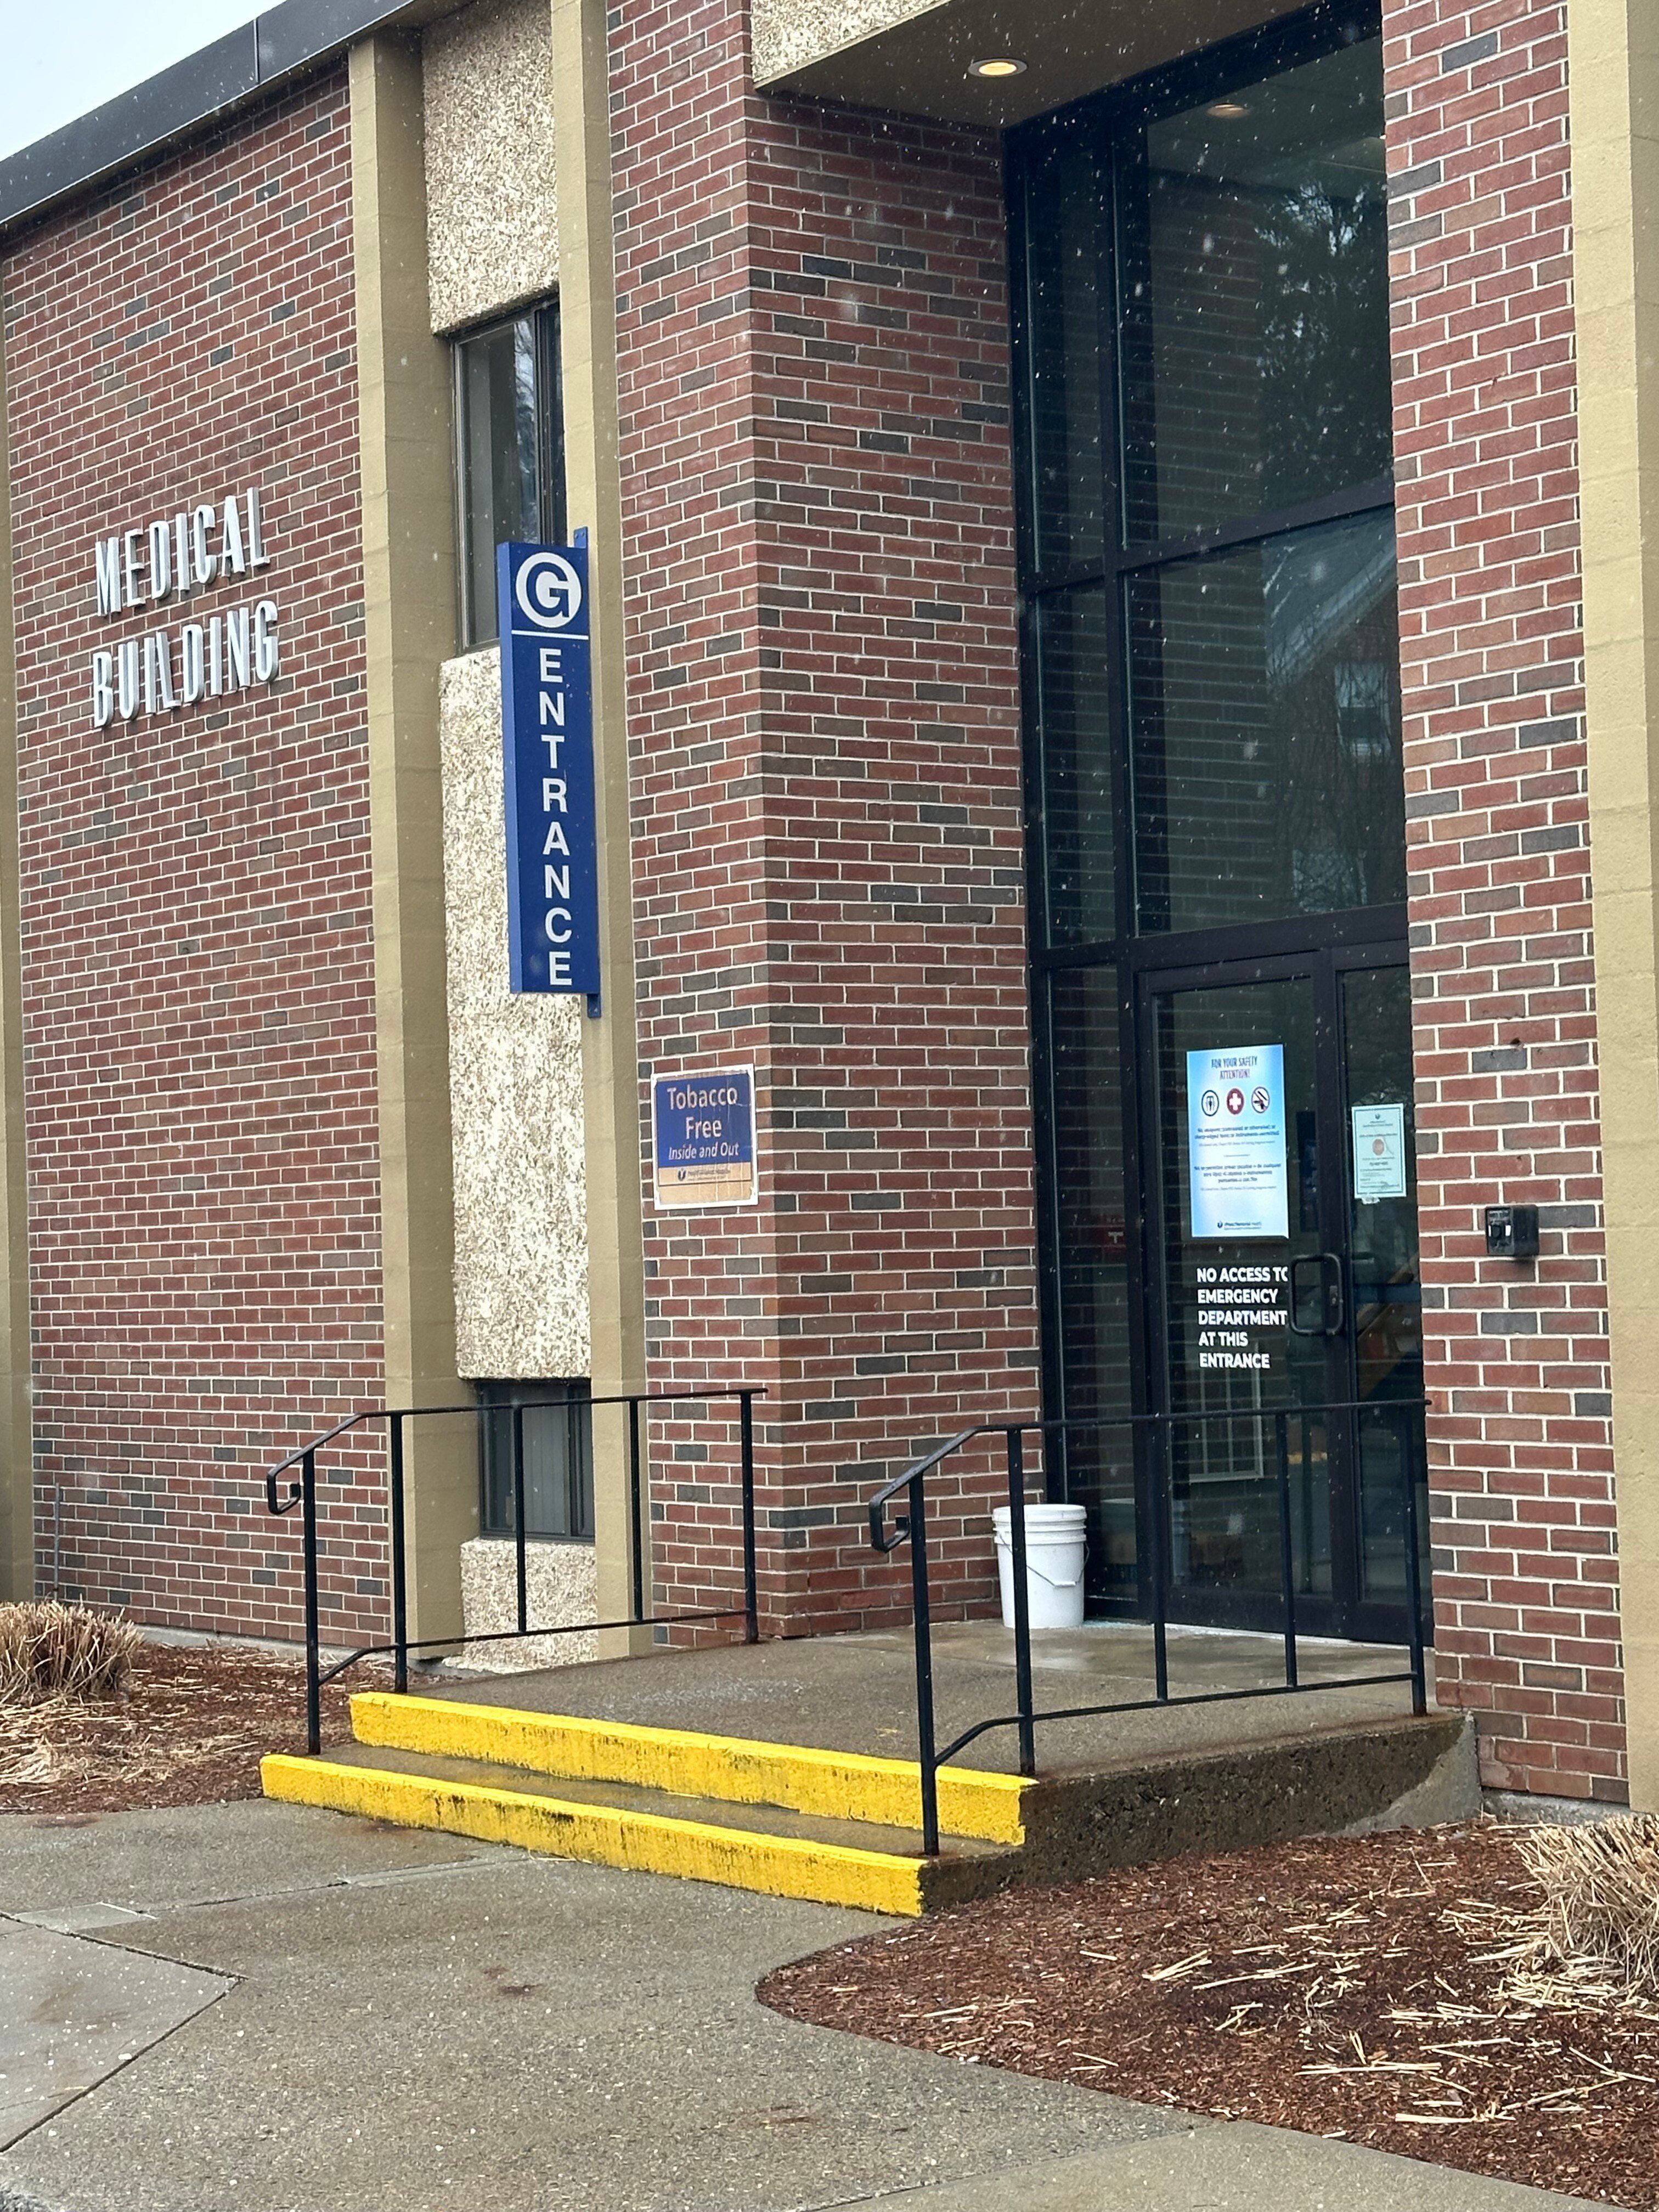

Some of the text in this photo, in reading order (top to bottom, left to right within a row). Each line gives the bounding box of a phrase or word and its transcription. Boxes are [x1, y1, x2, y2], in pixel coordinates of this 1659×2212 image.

[95, 487, 270, 617] MEDICAL
[526, 561, 569, 618] G
[92, 600, 279, 727] BUILDING
[539, 648, 572, 986] ENTRANCE
[1211, 1056, 1257, 1069] FOR YOUR SAFETY
[667, 1084, 738, 1110] Tobacco
[685, 1116, 723, 1139] Free
[668, 1142, 739, 1160] Inside and Out
[1197, 1268, 1217, 1282] NO
[1219, 1267, 1271, 1282] ACCESS
[1197, 1288, 1278, 1304] EMERGENCY
[1198, 1310, 1288, 1325] DEPARTMENT
[1199, 1331, 1249, 1347] AT THIS
[1199, 1352, 1271, 1369] ENTRANCE
